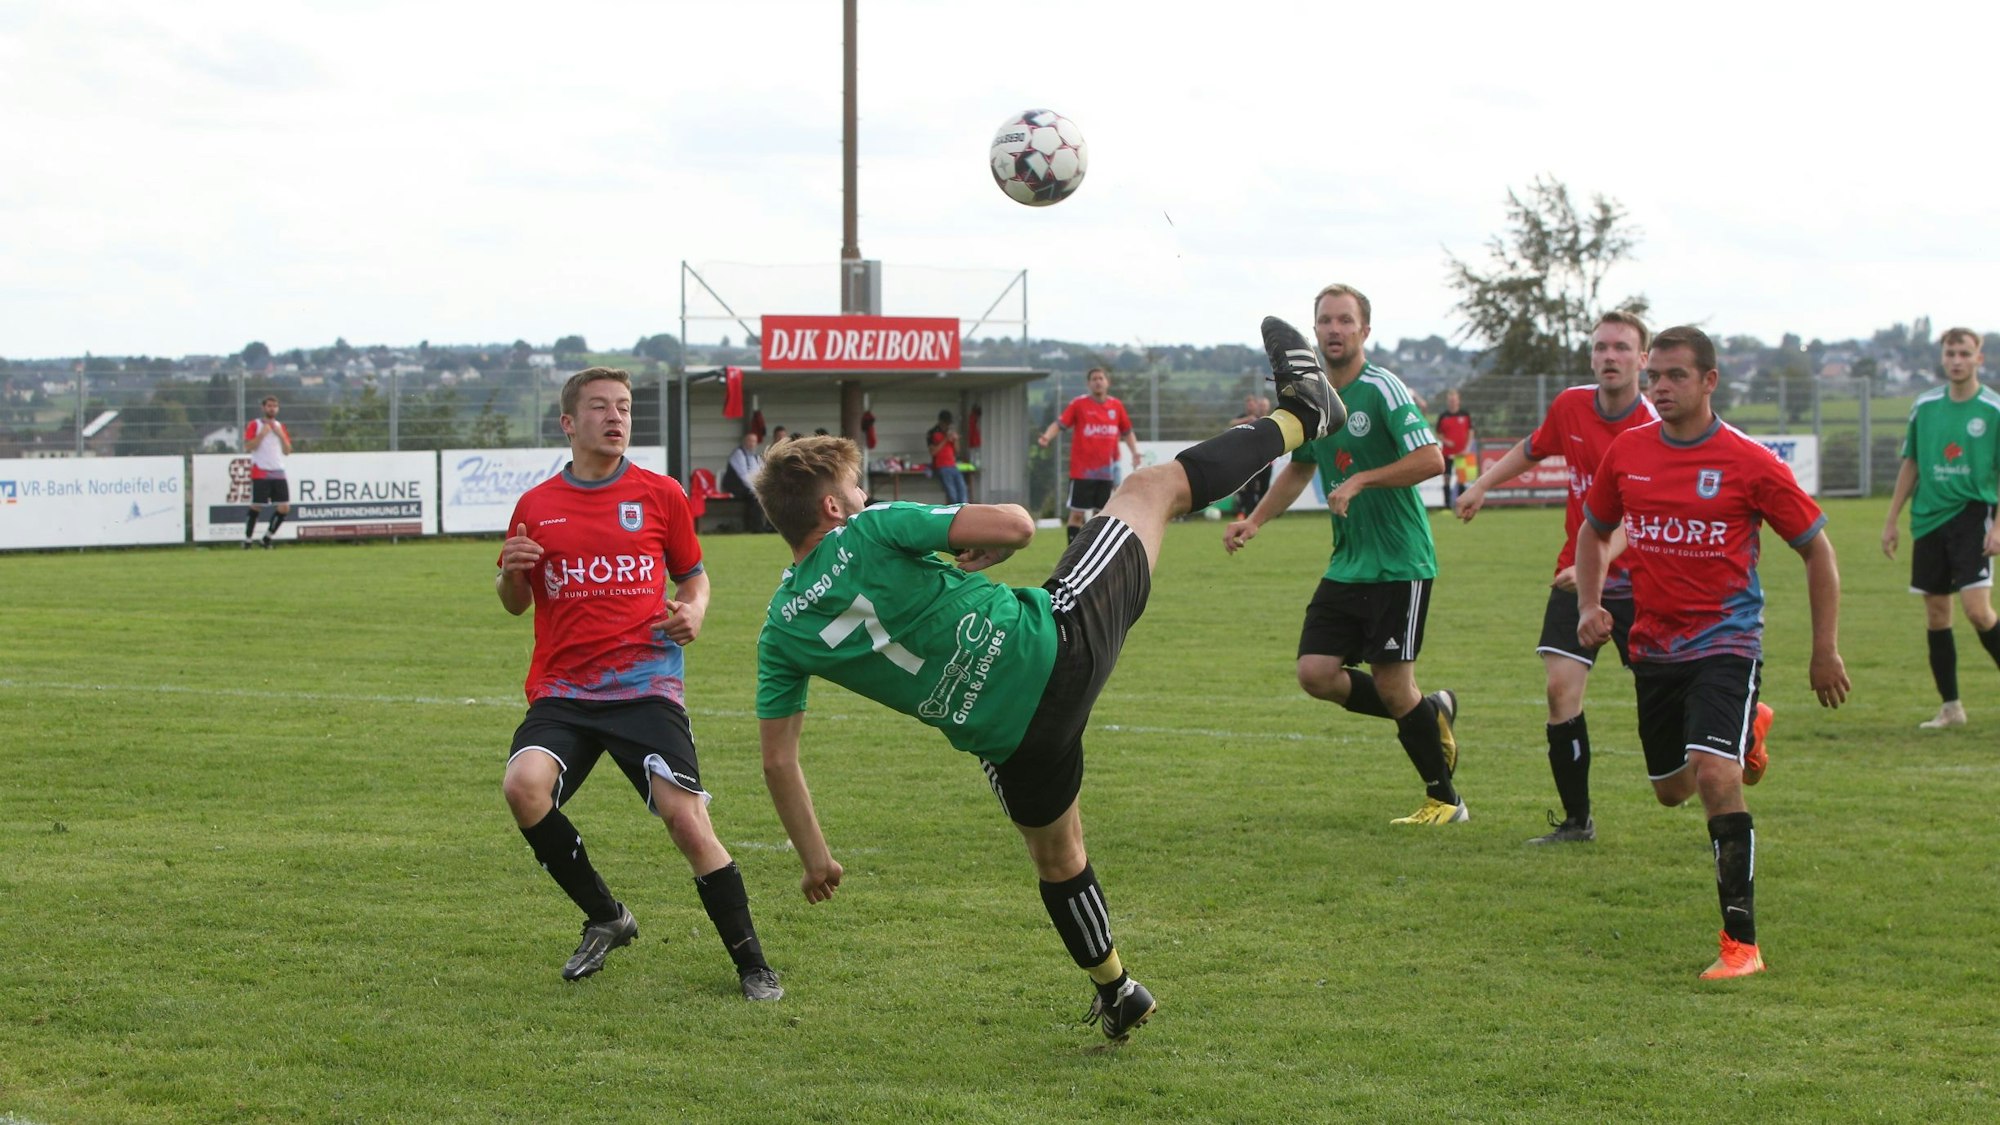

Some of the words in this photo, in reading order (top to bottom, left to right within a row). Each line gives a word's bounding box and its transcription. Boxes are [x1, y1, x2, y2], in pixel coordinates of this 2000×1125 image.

[768, 328, 821, 361] DJK
[824, 329, 955, 361] DREIBORN
[21, 480, 83, 496] VR-Bank
[89, 477, 154, 495] Nordeifel
[159, 477, 178, 493] eG
[539, 518, 567, 526] STANNO
[1641, 544, 1660, 553] RUND
[1678, 549, 1726, 557] EDELSTAHL
[562, 555, 655, 585] HÖRR
[832, 547, 853, 576] e.V.
[564, 591, 589, 599] RUND
[592, 589, 606, 597] UM
[609, 588, 655, 596] EDELSTAHL
[819, 593, 925, 675] 7
[975, 629, 1006, 681] Jöbges
[970, 681, 984, 692] &
[952, 691, 978, 725] Groß
[1707, 735, 1732, 745] STANNO
[673, 771, 696, 783] STANNO
